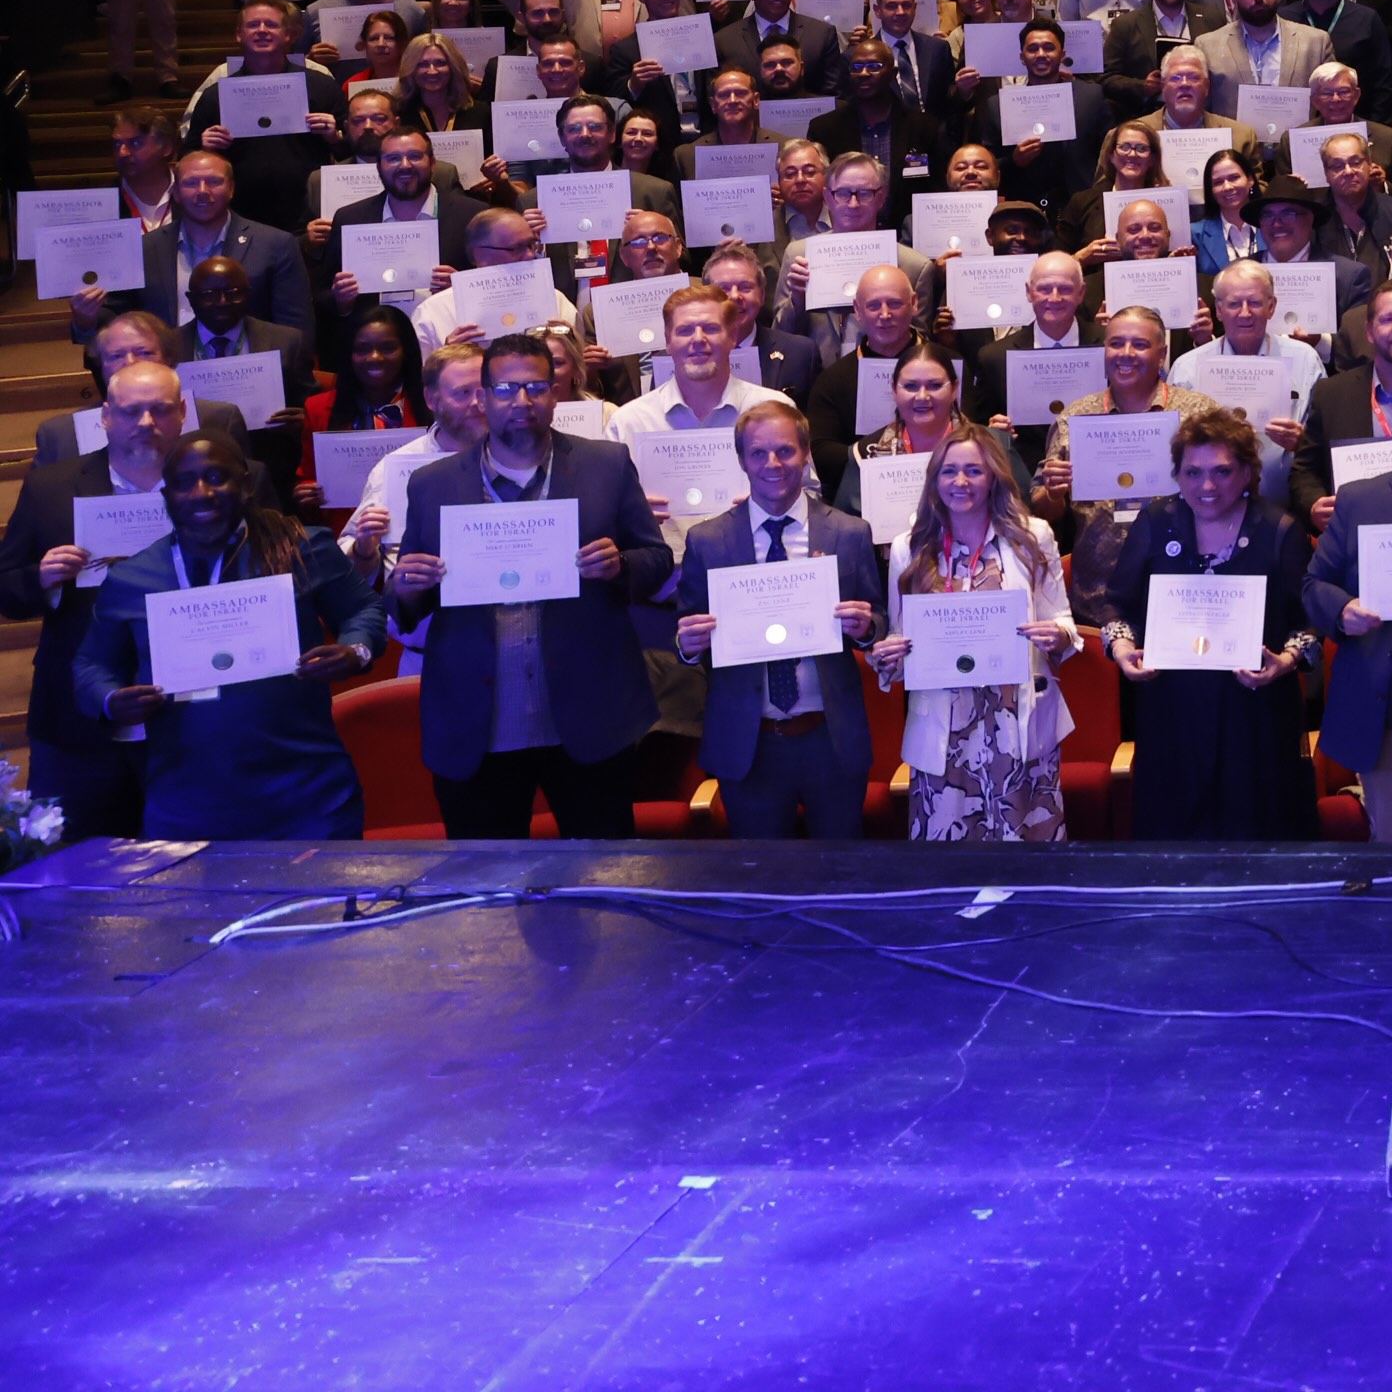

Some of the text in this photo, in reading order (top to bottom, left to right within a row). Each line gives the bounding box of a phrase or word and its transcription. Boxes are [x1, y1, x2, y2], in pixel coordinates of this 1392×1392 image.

[1085, 428, 1161, 439] AMBASSADOR
[653, 442, 732, 454] AMBASSADOR
[463, 517, 556, 532] AMBASSADOR
[481, 526, 536, 537] FOR ISRAEL
[730, 571, 817, 590] AMBASSADOR
[747, 583, 800, 594] FOR ISRAEL
[169, 594, 268, 616] AMBASSADOR
[188, 606, 248, 620] FOR ISRAEL
[923, 605, 1008, 618] AMBASSADOR
[940, 613, 991, 624] FOR ISRAEL
